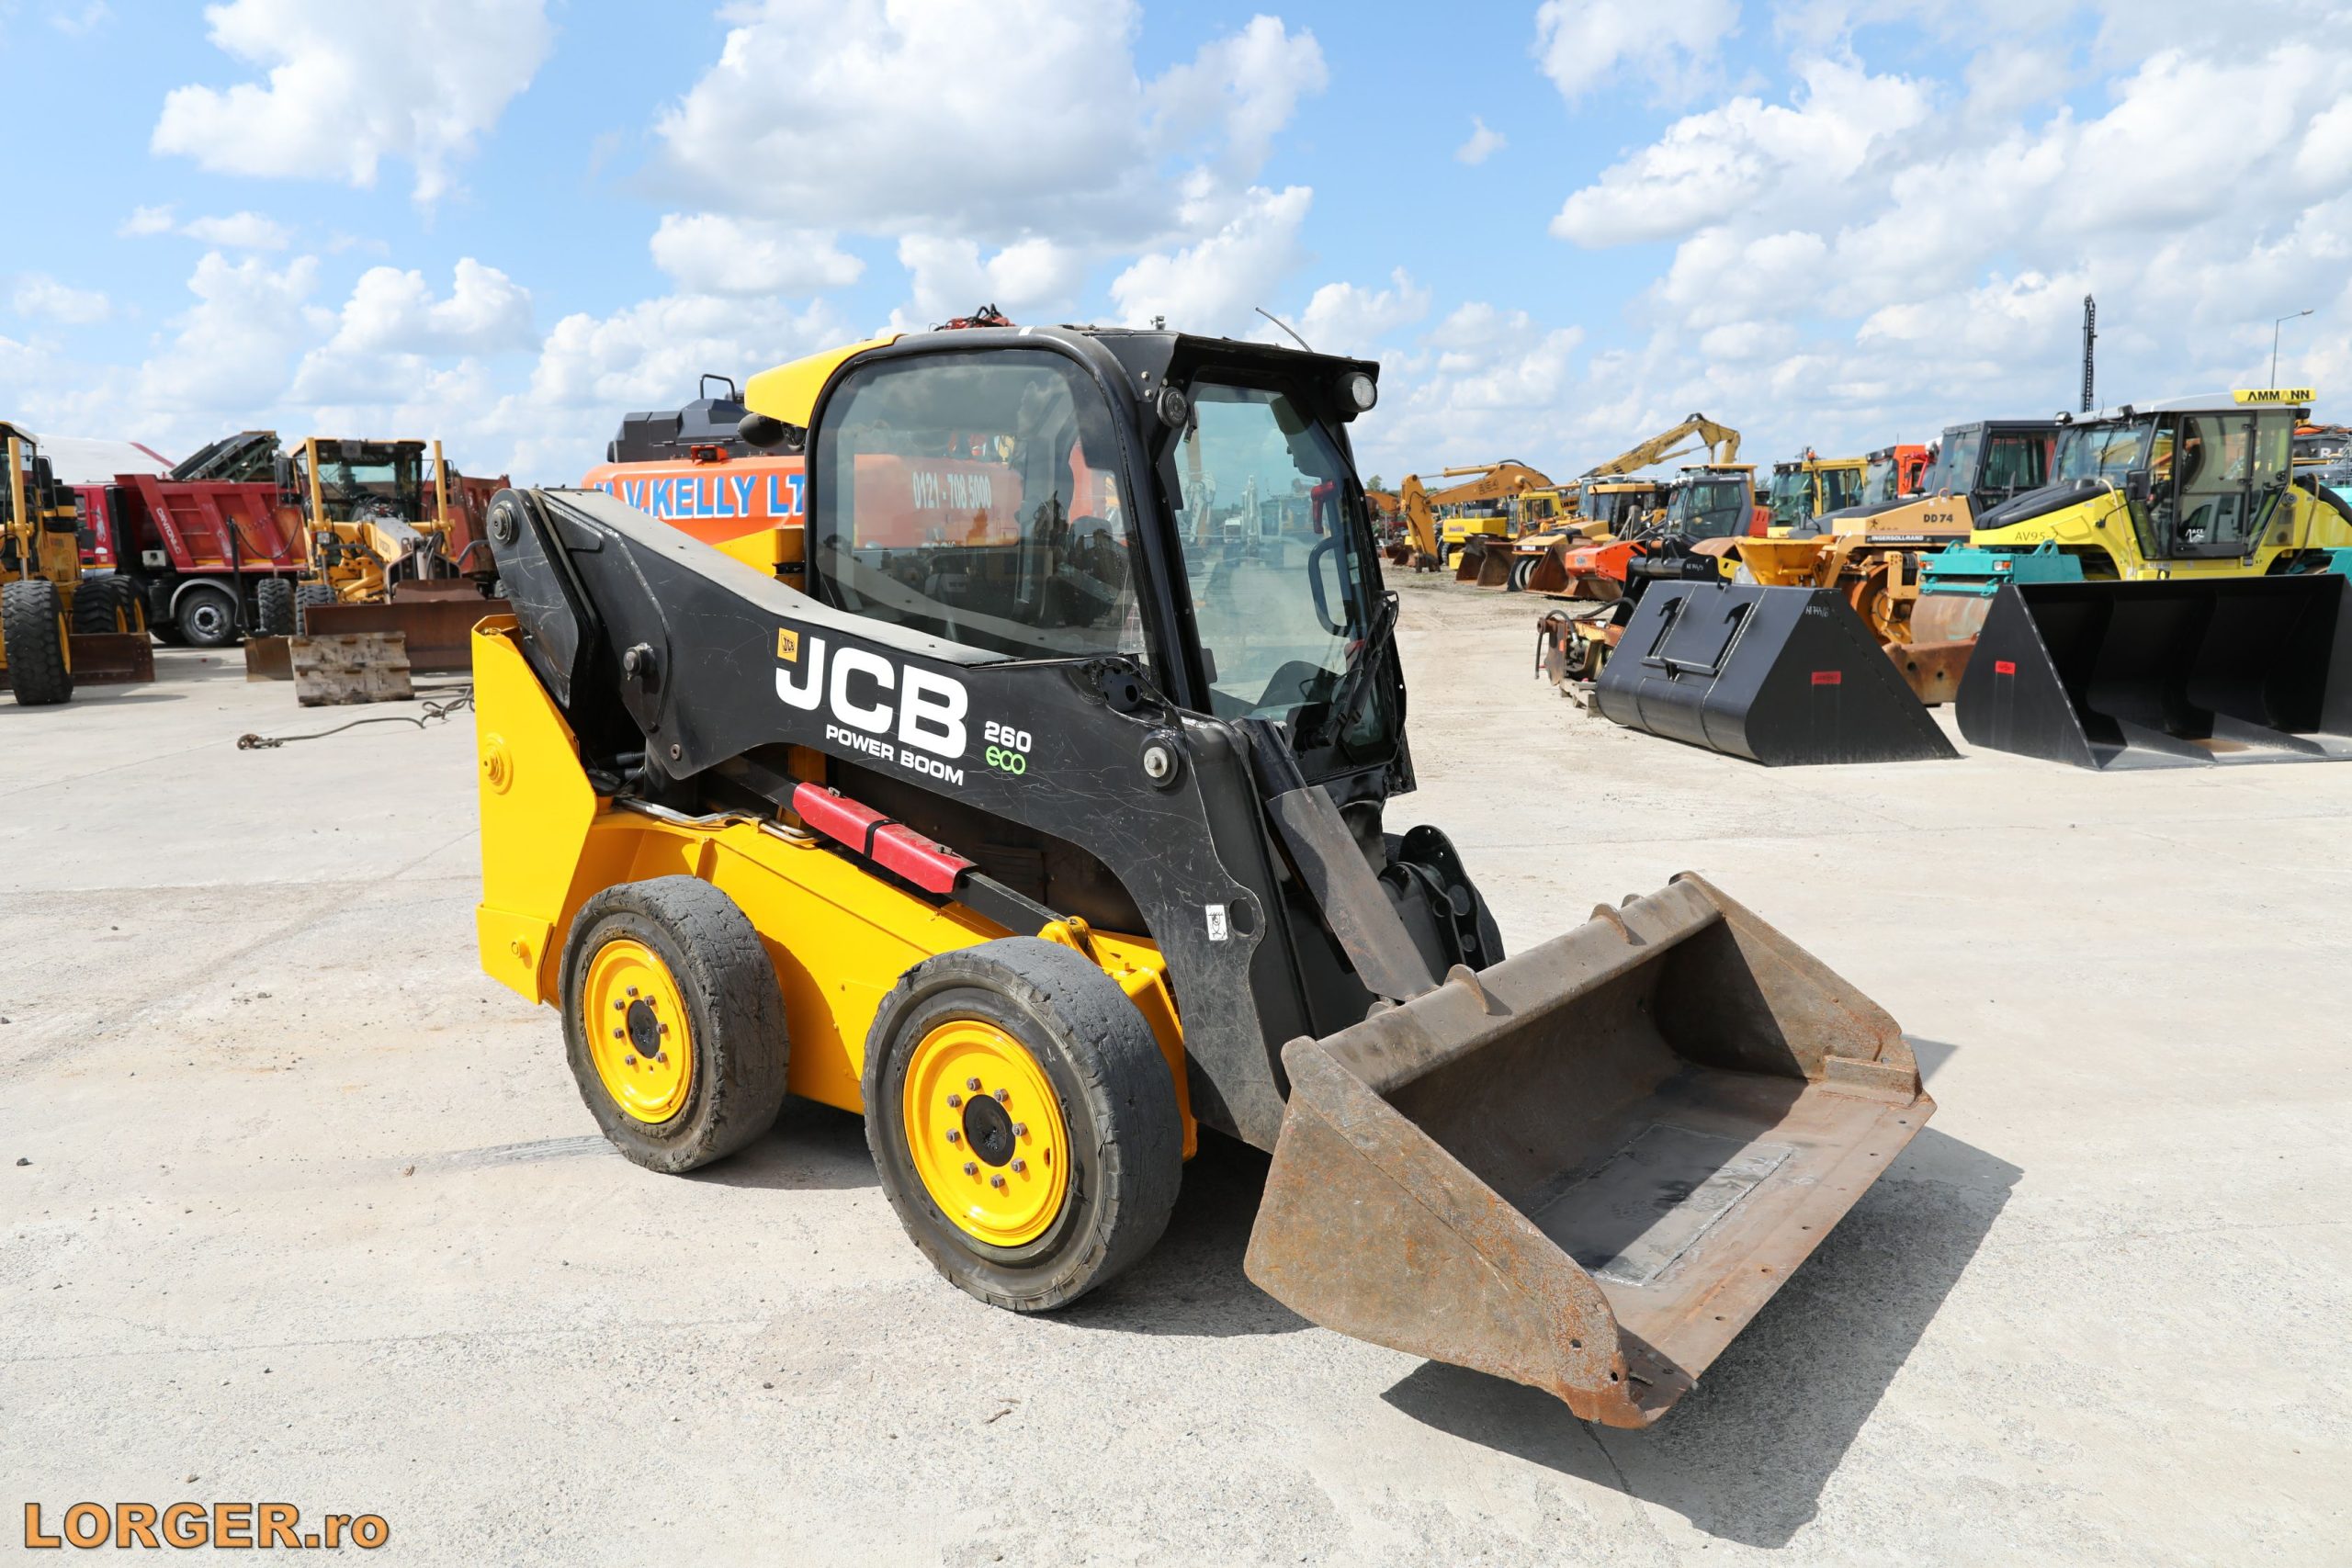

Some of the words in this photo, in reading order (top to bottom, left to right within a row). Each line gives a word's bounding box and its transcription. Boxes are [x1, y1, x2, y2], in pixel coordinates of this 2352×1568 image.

[2247, 389, 2310, 401] AMMANN
[766, 474, 806, 517] LT
[912, 471, 940, 509] 0121
[946, 473, 967, 509] 708
[967, 474, 992, 509] 5000
[1923, 513, 1938, 523] DD
[1939, 513, 1953, 523] 74
[775, 636, 968, 760] JCB
[984, 720, 1033, 753] 260
[825, 723, 895, 761] POWER
[899, 748, 965, 786] BOOM
[985, 744, 1027, 776] eco
